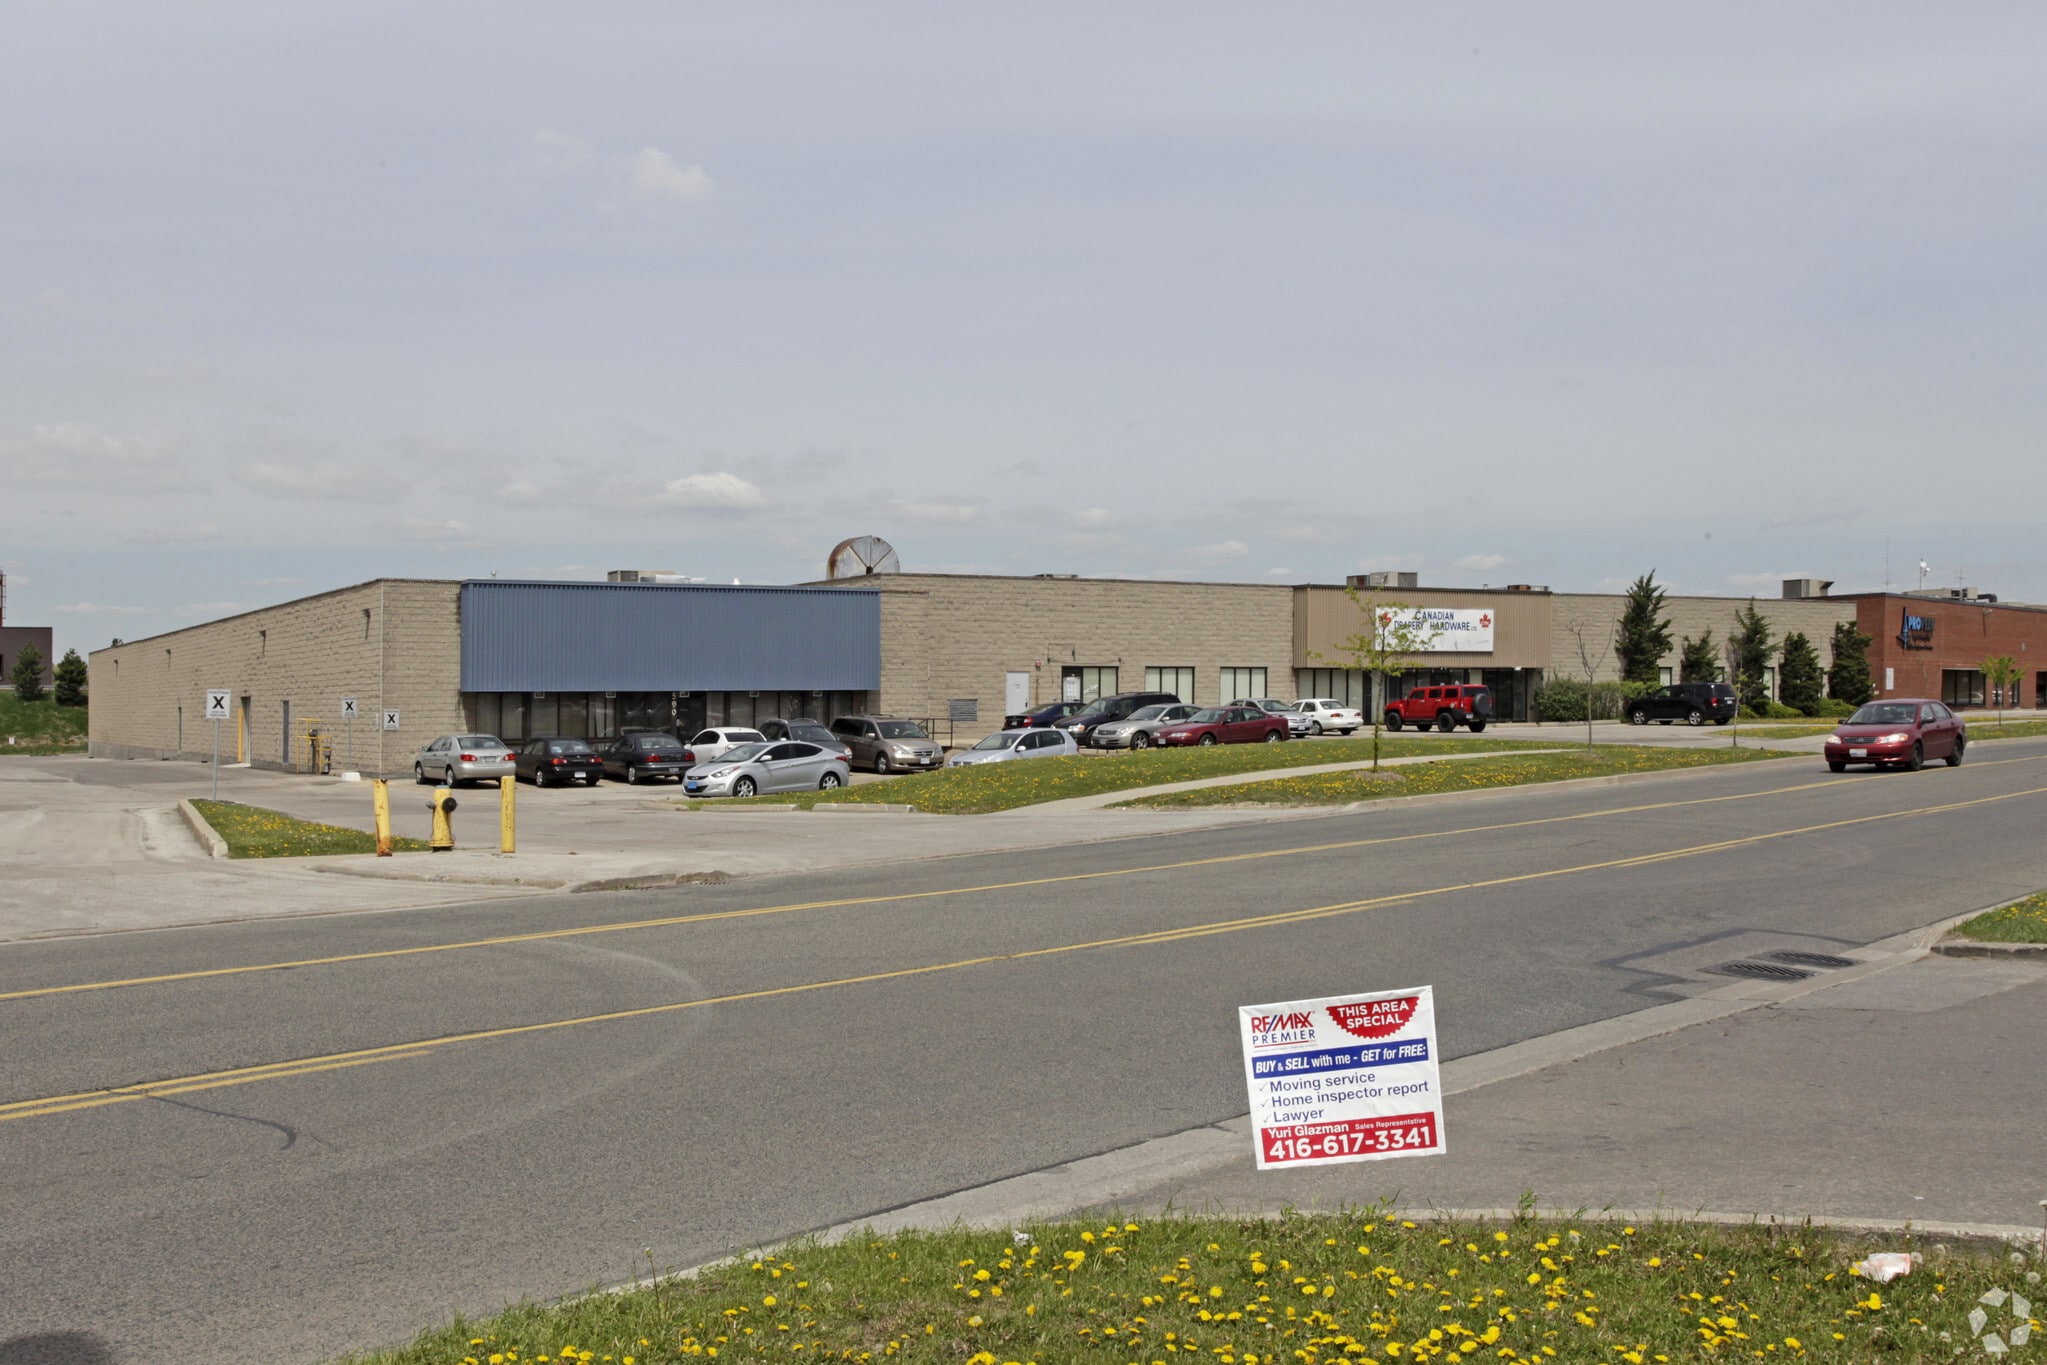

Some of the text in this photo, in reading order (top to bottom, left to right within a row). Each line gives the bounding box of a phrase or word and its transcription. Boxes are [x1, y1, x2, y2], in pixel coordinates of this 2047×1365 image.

[1415, 610, 1454, 620] CANADIAN
[1430, 621, 1470, 631] HARDWARE
[1337, 1000, 1409, 1018] THIS AREA
[1251, 1010, 1314, 1034] RE/MAX
[1346, 1013, 1404, 1029] SPECIAL
[1252, 1029, 1316, 1046] PREMIER
[1255, 1060, 1276, 1074] BUY
[1277, 1062, 1284, 1071] &
[1285, 1056, 1310, 1071] SELL
[1311, 1054, 1333, 1068] with
[1335, 1054, 1351, 1065] me
[1361, 1048, 1381, 1062] GET
[1383, 1048, 1397, 1060] for
[1398, 1044, 1426, 1059] FREE:
[1270, 1072, 1376, 1093] Moving service
[1271, 1080, 1429, 1108] Home inspector report
[1273, 1108, 1325, 1123] Lawyer
[1267, 1117, 1427, 1139] Yuri Glazman Sales Representative
[1269, 1125, 1431, 1159] 416-617-3341
